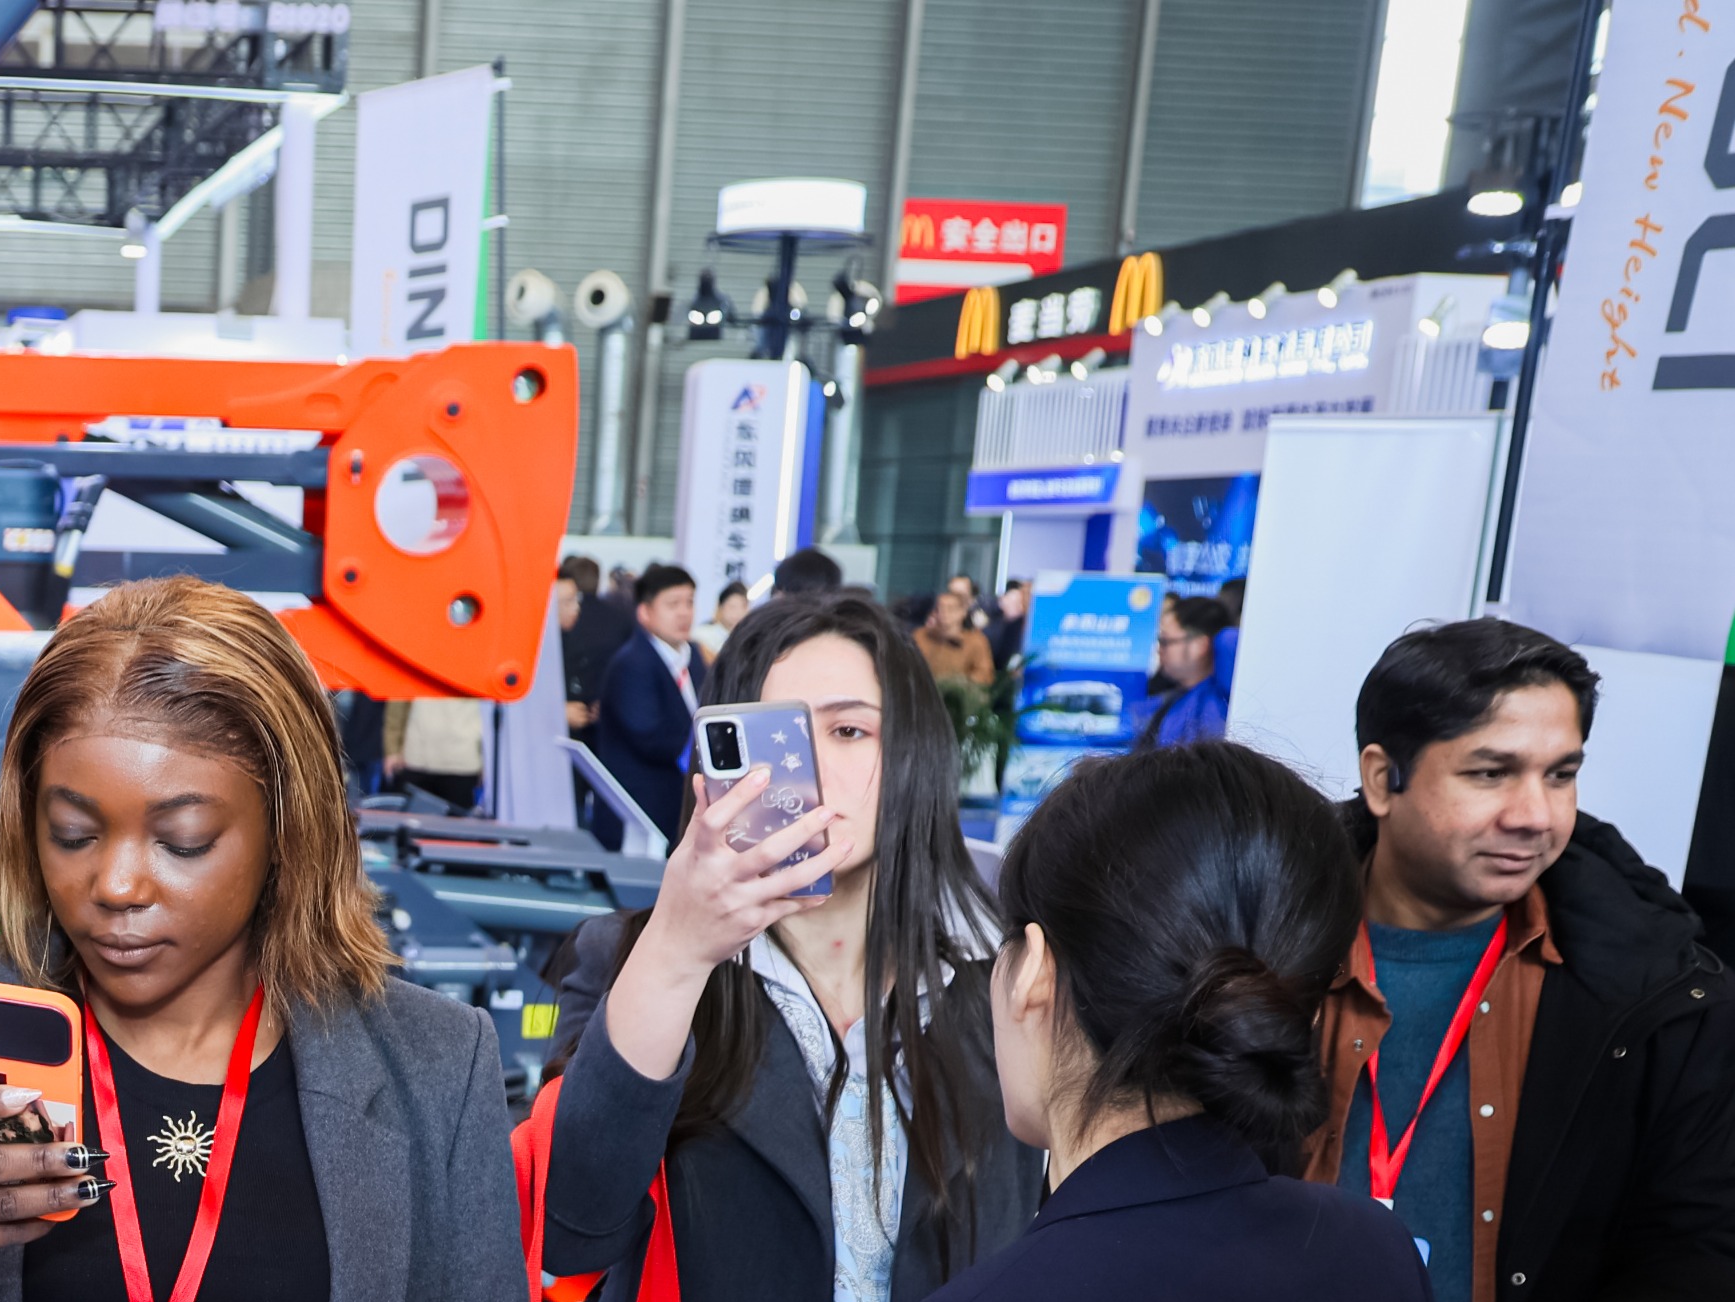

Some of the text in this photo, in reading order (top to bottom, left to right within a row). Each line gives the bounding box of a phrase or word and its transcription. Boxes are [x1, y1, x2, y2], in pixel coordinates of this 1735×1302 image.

[940, 216, 1059, 255] 安全出口
[1600, 78, 1697, 392] New Height
[1007, 286, 1102, 345] 麦当劳
